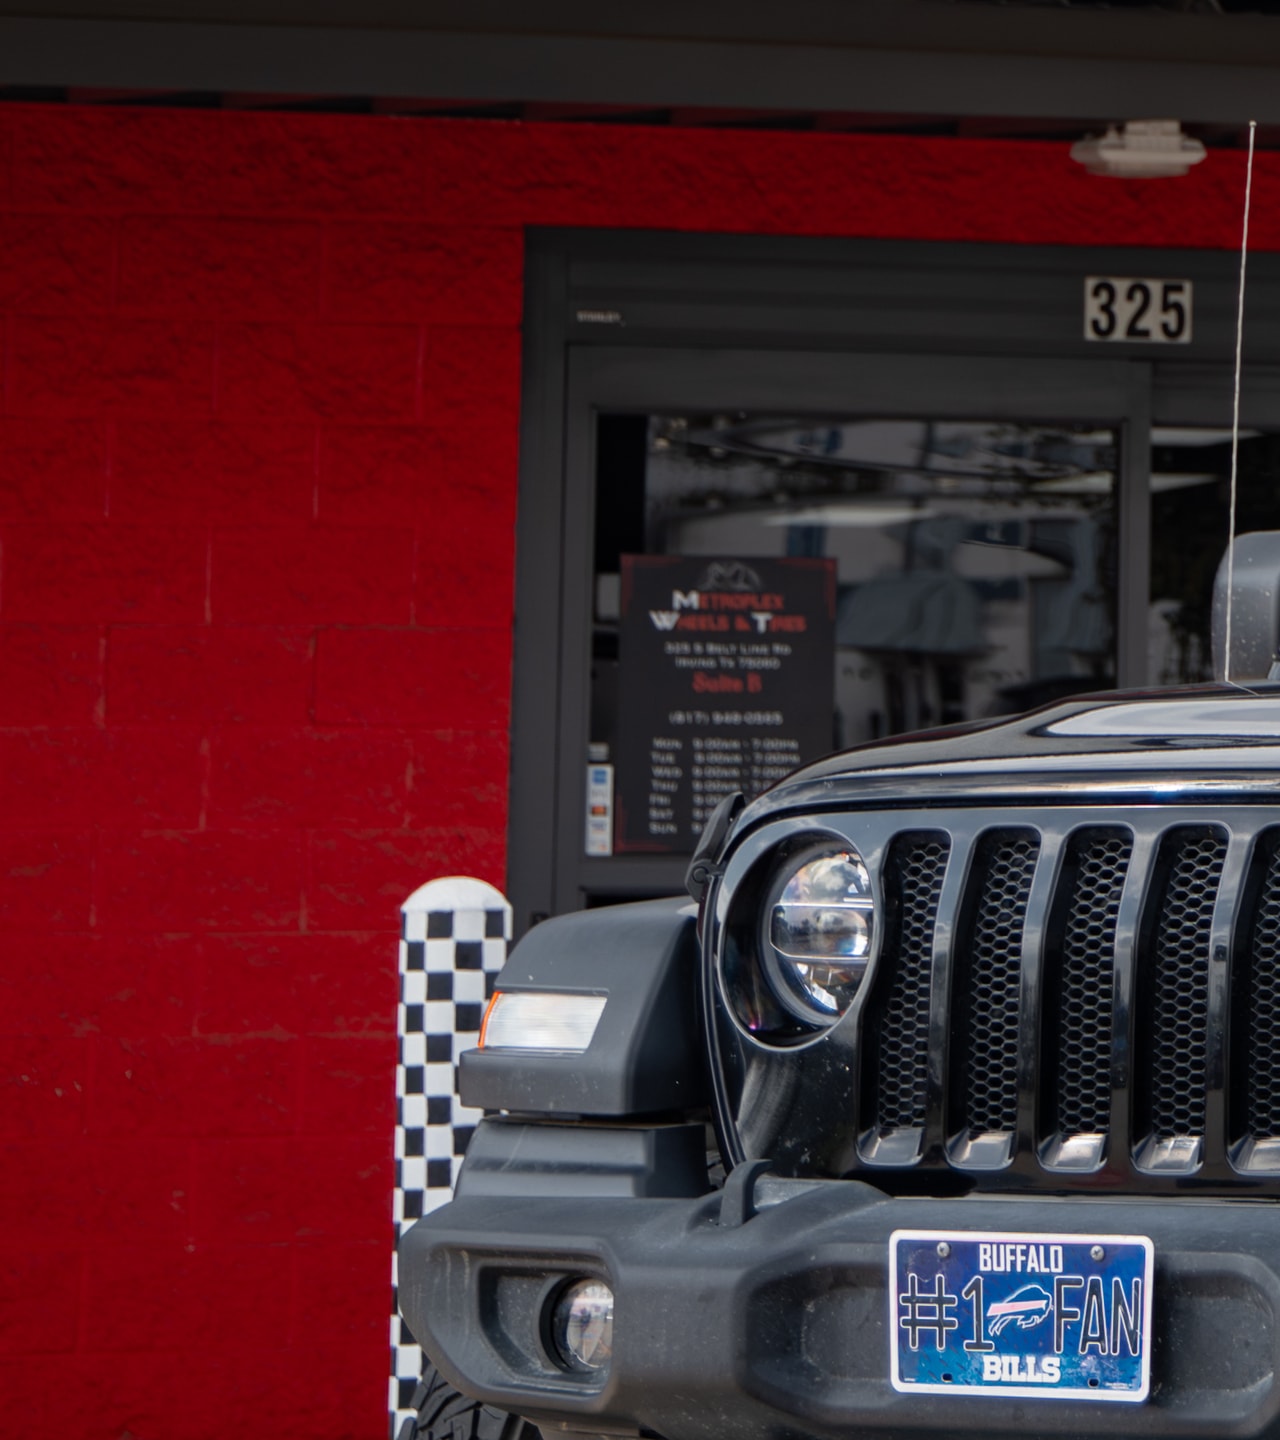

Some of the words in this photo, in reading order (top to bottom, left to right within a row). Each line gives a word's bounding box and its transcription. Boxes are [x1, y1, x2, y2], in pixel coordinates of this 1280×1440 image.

[1091, 281, 1185, 339] 325
[979, 1244, 1064, 1273] BUFFALO
[900, 1273, 996, 1352] #1
[1053, 1276, 1142, 1356] FAN
[983, 1355, 1062, 1383] BILLS
